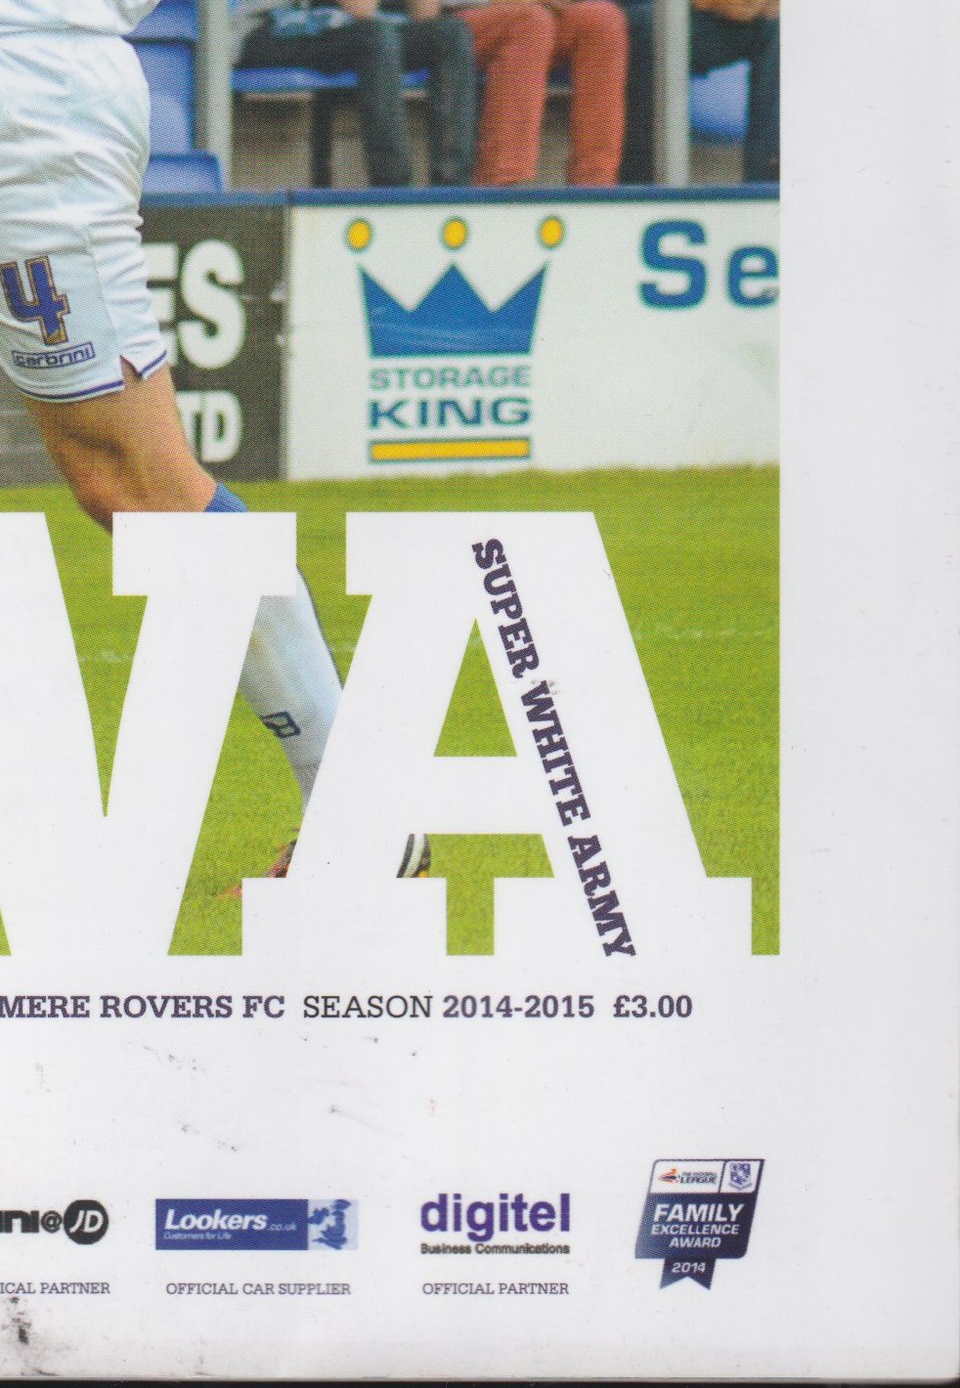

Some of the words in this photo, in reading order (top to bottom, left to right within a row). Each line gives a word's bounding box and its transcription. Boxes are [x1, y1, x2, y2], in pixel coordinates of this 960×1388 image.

[640, 218, 778, 309] Se
[369, 365, 531, 389] STORAGE
[368, 396, 531, 430] KING
[472, 538, 540, 679] SUPER
[521, 679, 591, 826] WHITE
[568, 835, 636, 957] ARMY
[100, 994, 233, 1018] ROVERS
[242, 994, 285, 1018] FC
[303, 994, 433, 1018] SEASON
[443, 994, 595, 1019] 2014-2015
[613, 994, 693, 1019] £3.00
[421, 1193, 570, 1242] digitel
[653, 1203, 744, 1222] FAMILY
[651, 1224, 740, 1235] EXCELLENCE
[421, 1243, 472, 1255] Business
[475, 1243, 570, 1255] Communications
[669, 1237, 721, 1248] AWARD
[671, 1262, 706, 1273] 2014
[40, 1282, 111, 1295] PARTNER
[166, 1283, 239, 1295] OFFICIAL
[242, 1283, 275, 1295] CAR
[278, 1283, 352, 1295] SUPPLIER
[422, 1283, 495, 1295] OFFICIAL
[498, 1283, 569, 1295] PARTNER
